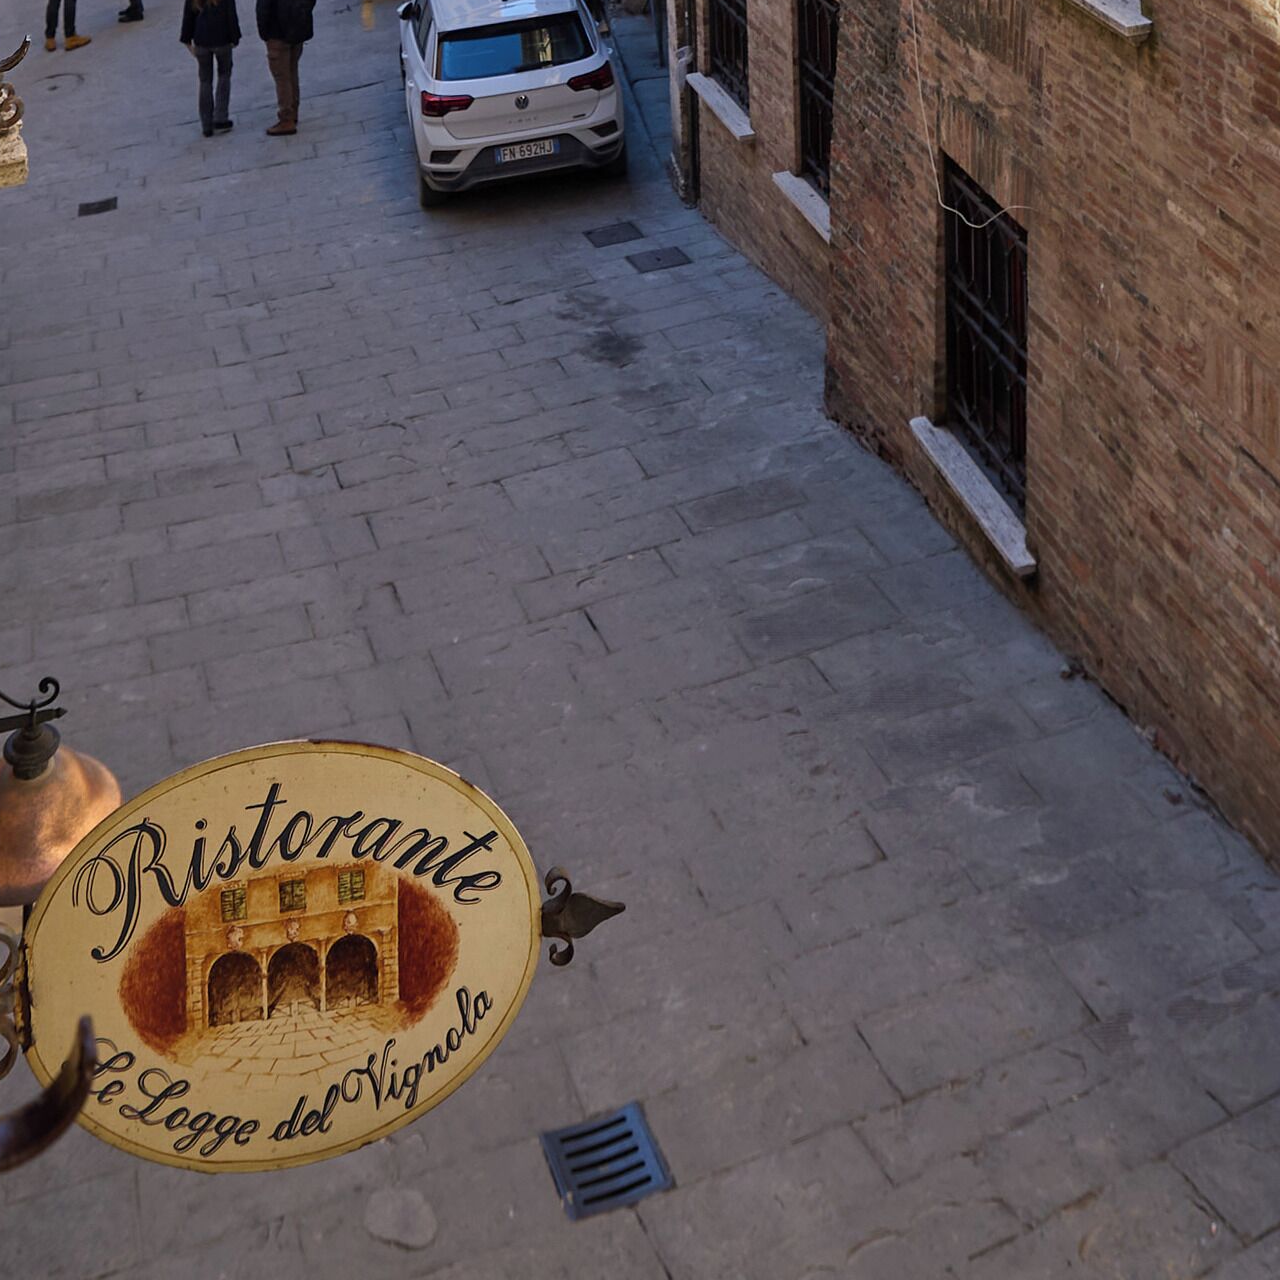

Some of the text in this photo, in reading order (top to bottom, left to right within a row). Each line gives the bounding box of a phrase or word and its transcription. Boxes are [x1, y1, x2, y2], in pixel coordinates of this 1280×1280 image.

[502, 140, 553, 160] FN 692HJ
[72, 783, 502, 963] Ristorante
[119, 1067, 260, 1157] Logge
[268, 1081, 340, 1141] del
[341, 985, 493, 1110] Vignola
